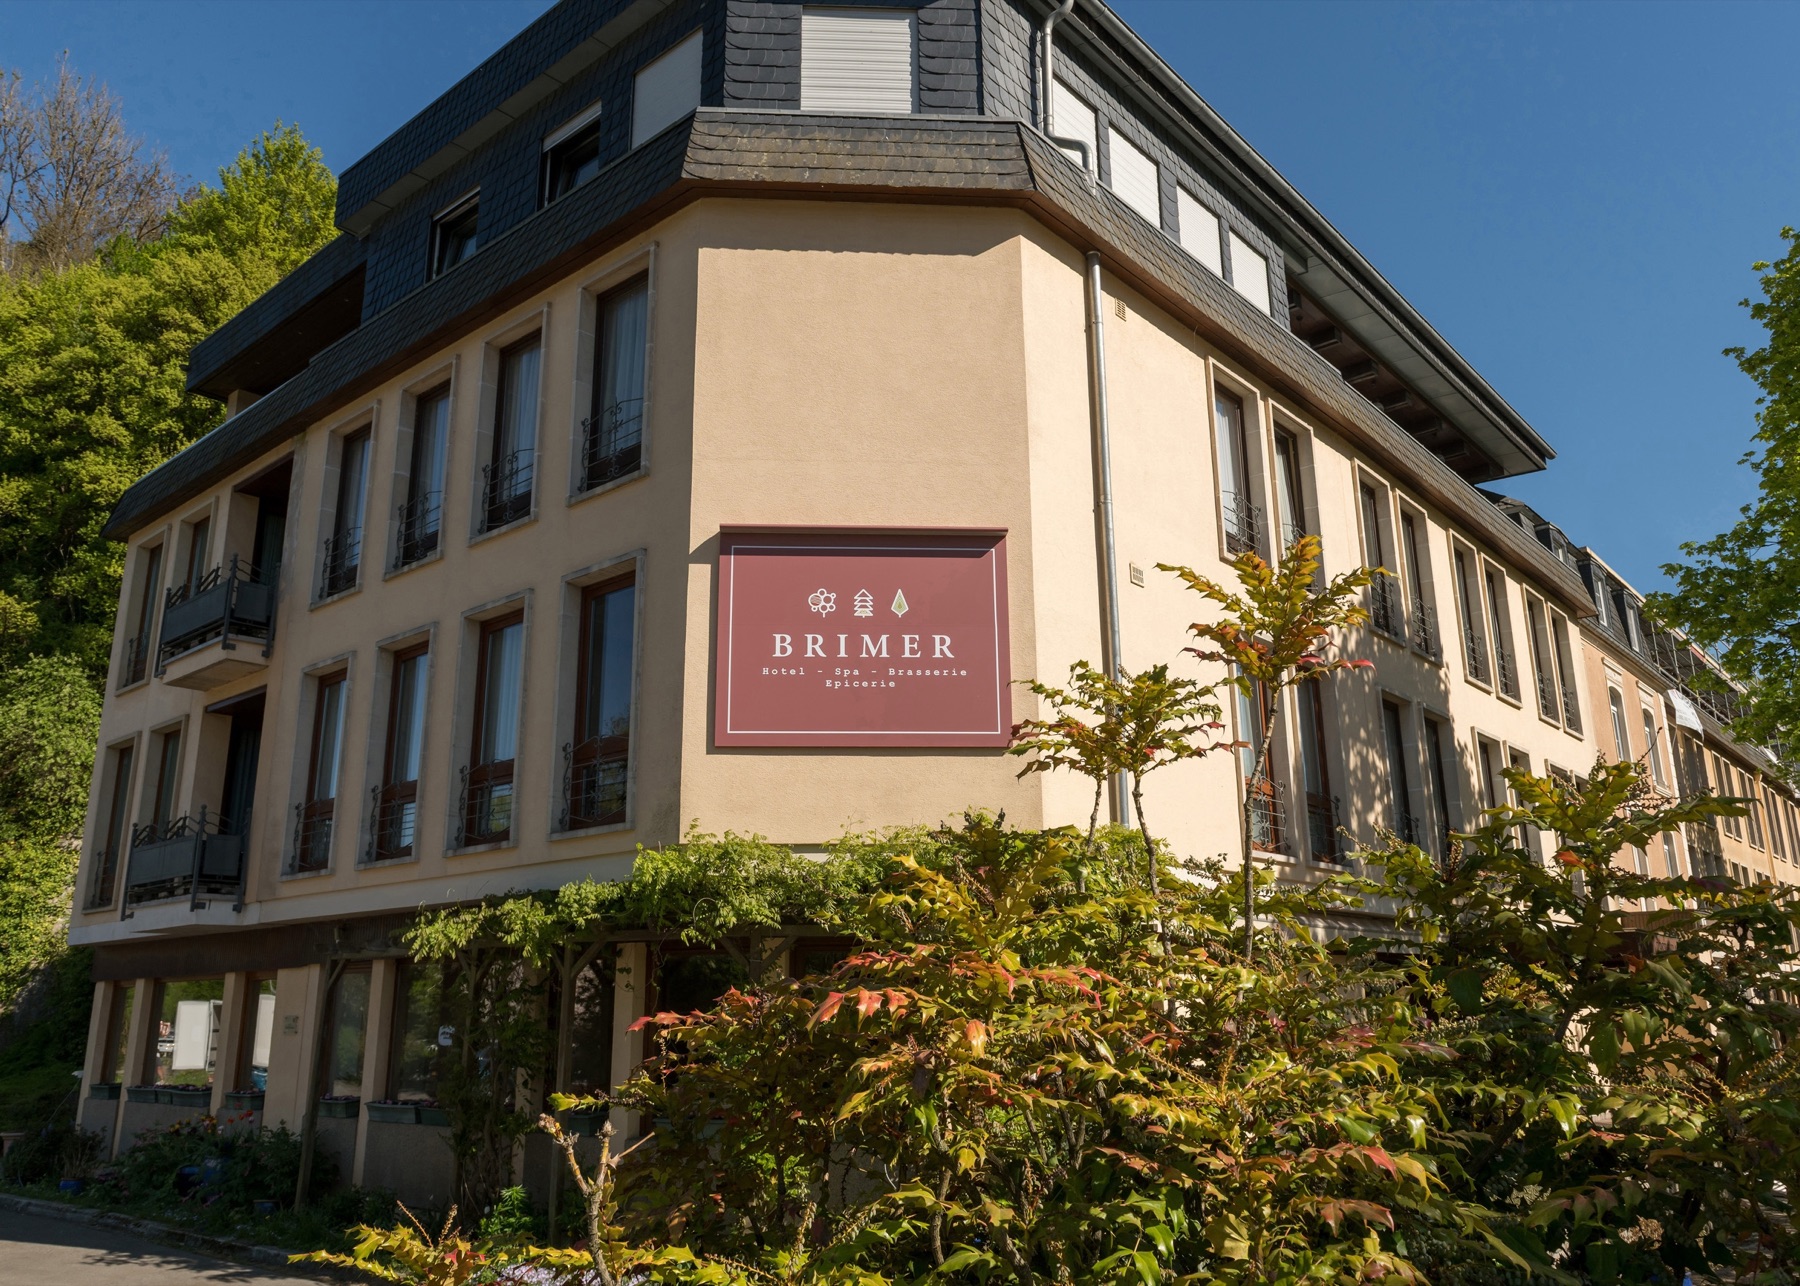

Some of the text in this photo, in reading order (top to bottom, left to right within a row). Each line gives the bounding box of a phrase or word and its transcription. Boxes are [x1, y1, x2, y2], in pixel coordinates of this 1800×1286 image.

[771, 632, 955, 659] BRIMER
[761, 666, 806, 676] Hotel
[834, 666, 860, 677] Spa
[887, 667, 967, 677] Brasserie
[825, 679, 896, 689] Epicerie
